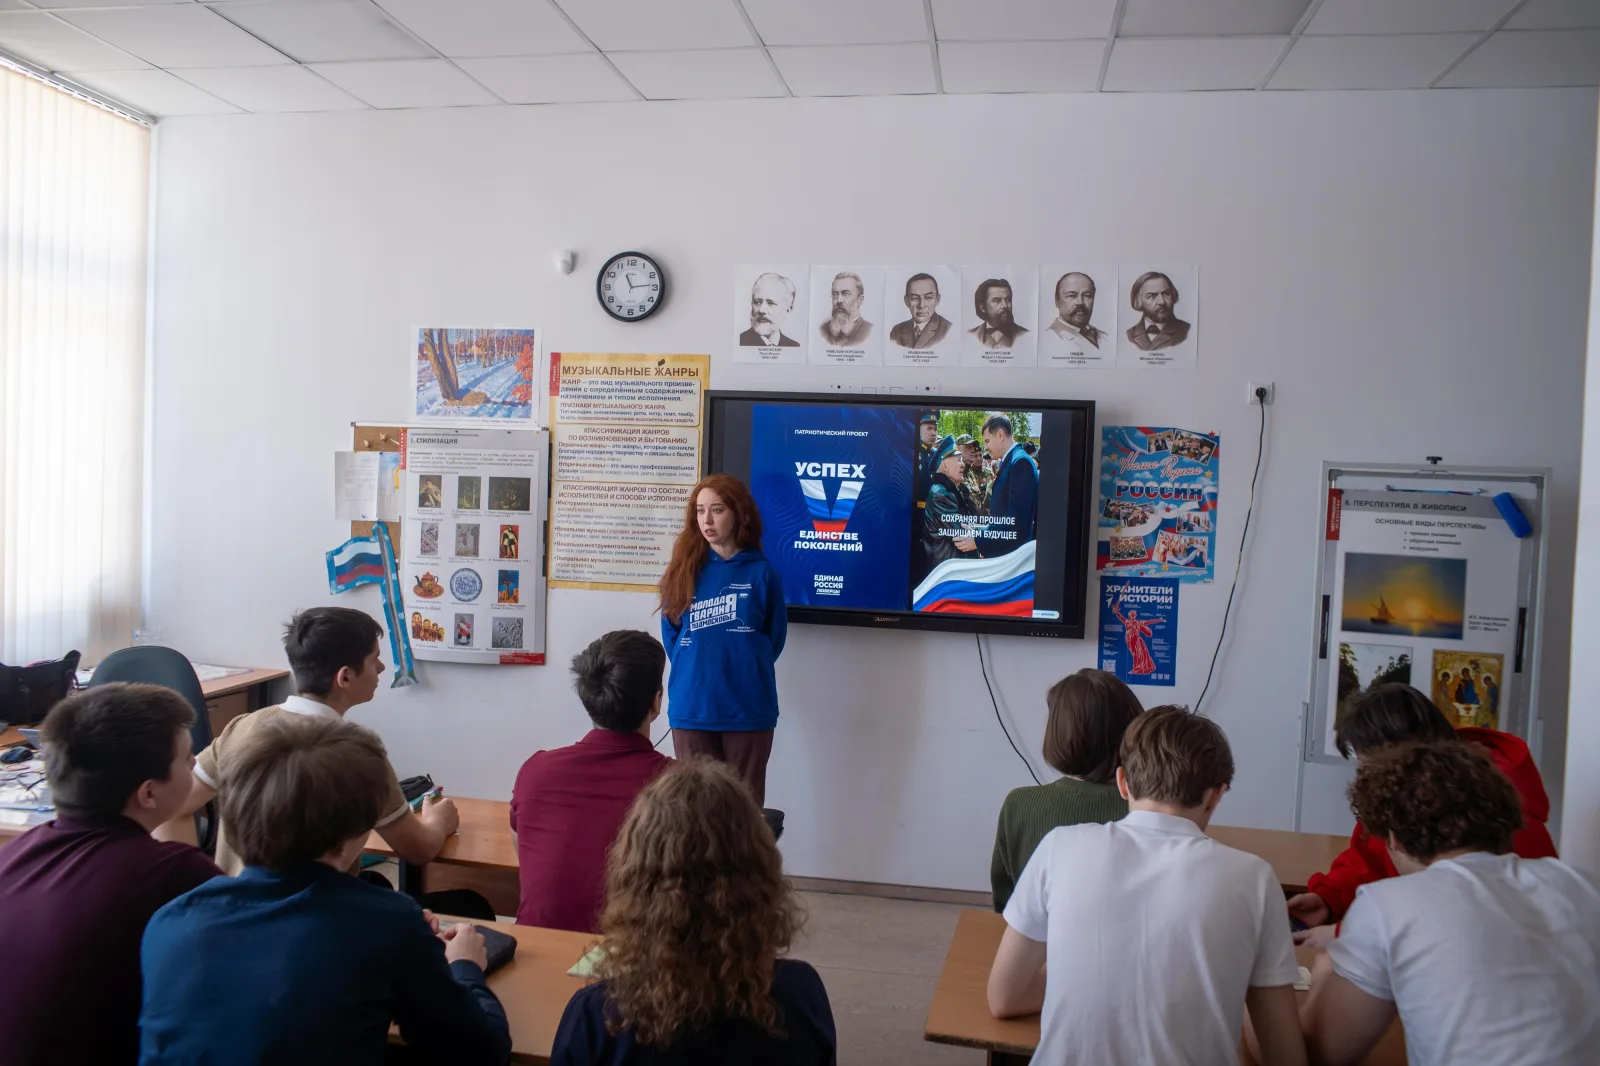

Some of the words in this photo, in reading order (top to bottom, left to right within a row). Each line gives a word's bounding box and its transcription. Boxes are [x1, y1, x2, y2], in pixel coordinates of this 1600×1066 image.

[562, 366, 651, 376] МУЗЫКАЛЬНЫЕ
[654, 367, 699, 376] ЖАНРЫ
[1120, 451, 1159, 474] Наша
[795, 462, 866, 478] УСПЕХ
[1160, 456, 1203, 482] Родина
[1116, 480, 1203, 500] РОССИЯ
[1354, 500, 1410, 508] ПЕРСПЕКТИВА
[941, 514, 978, 524] СОХРАНЯЯ
[980, 516, 1016, 525] ПРОШЛОЕ
[799, 530, 858, 541] ЕДИНСТВЕ
[938, 528, 982, 538] ЗАЩИЩАЕМ
[983, 530, 1017, 540] БУДУЩЕЕ
[794, 541, 863, 552] ПОКОЛЕНИЙ
[1106, 585, 1173, 594] ХРАНИТЕЛИ
[690, 593, 737, 612] МОЛОДАЯ
[1120, 594, 1173, 604] ИСТОРИИ
[692, 614, 734, 629] ПОДМОСКОВЬЕ
